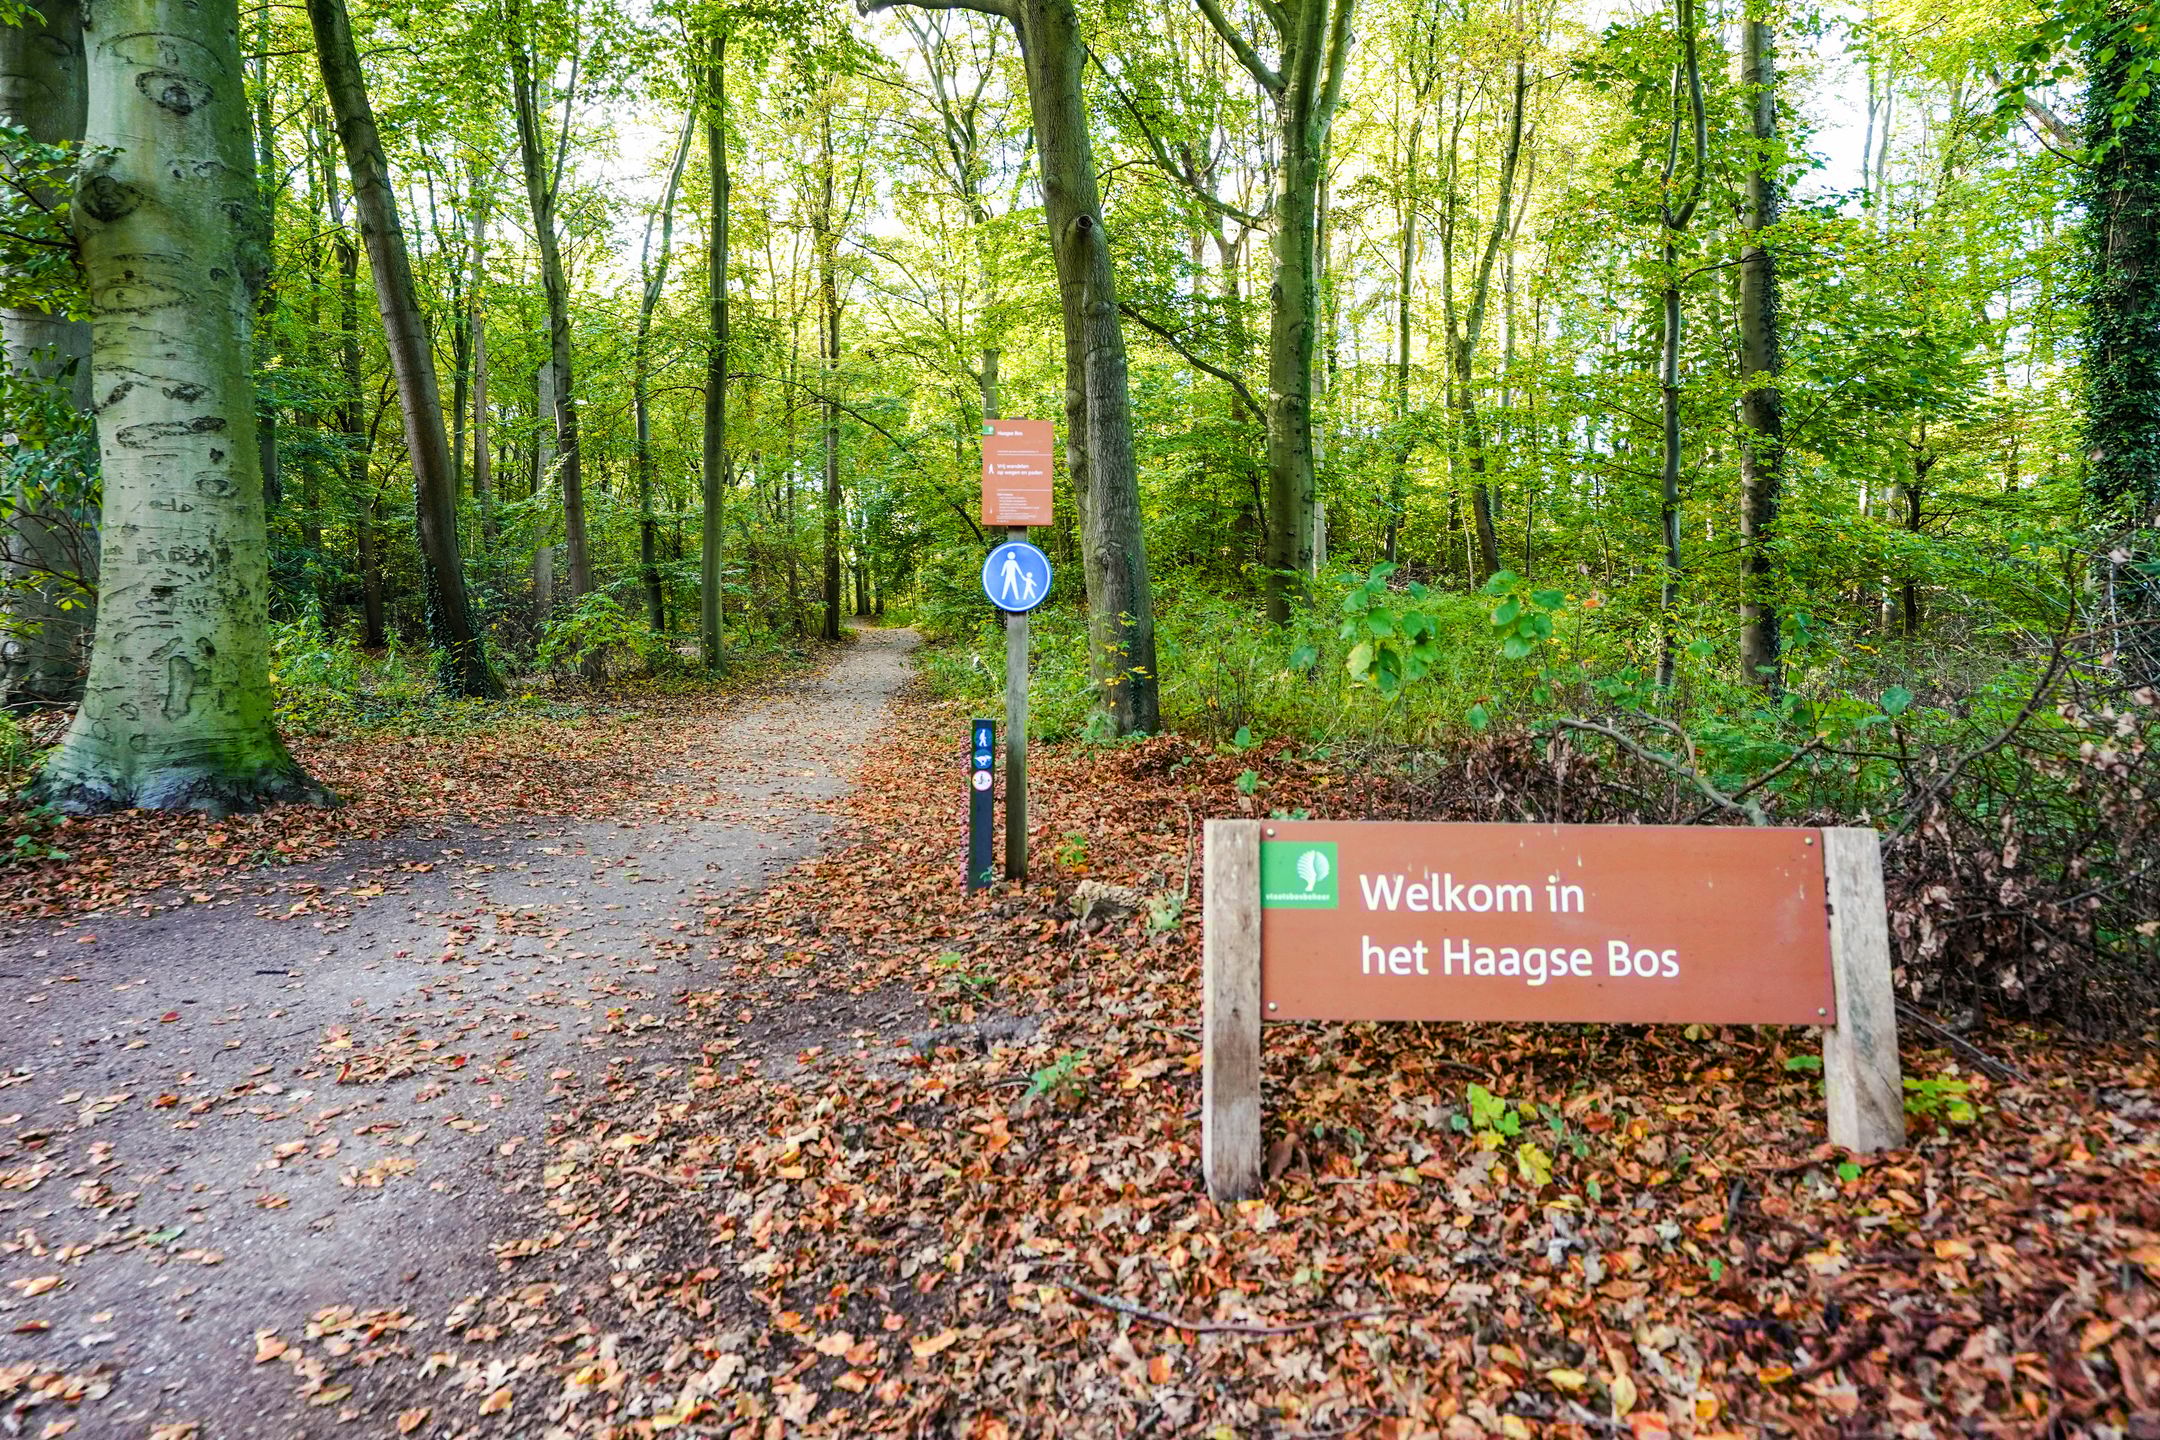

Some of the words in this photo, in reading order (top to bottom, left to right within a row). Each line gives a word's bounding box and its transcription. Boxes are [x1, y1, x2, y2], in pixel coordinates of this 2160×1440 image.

[1360, 872, 1533, 913] Welkom
[1547, 876, 1585, 913] in
[1361, 936, 1429, 976] het
[1444, 938, 1593, 985] Haagse
[1609, 940, 1681, 978] Bos
